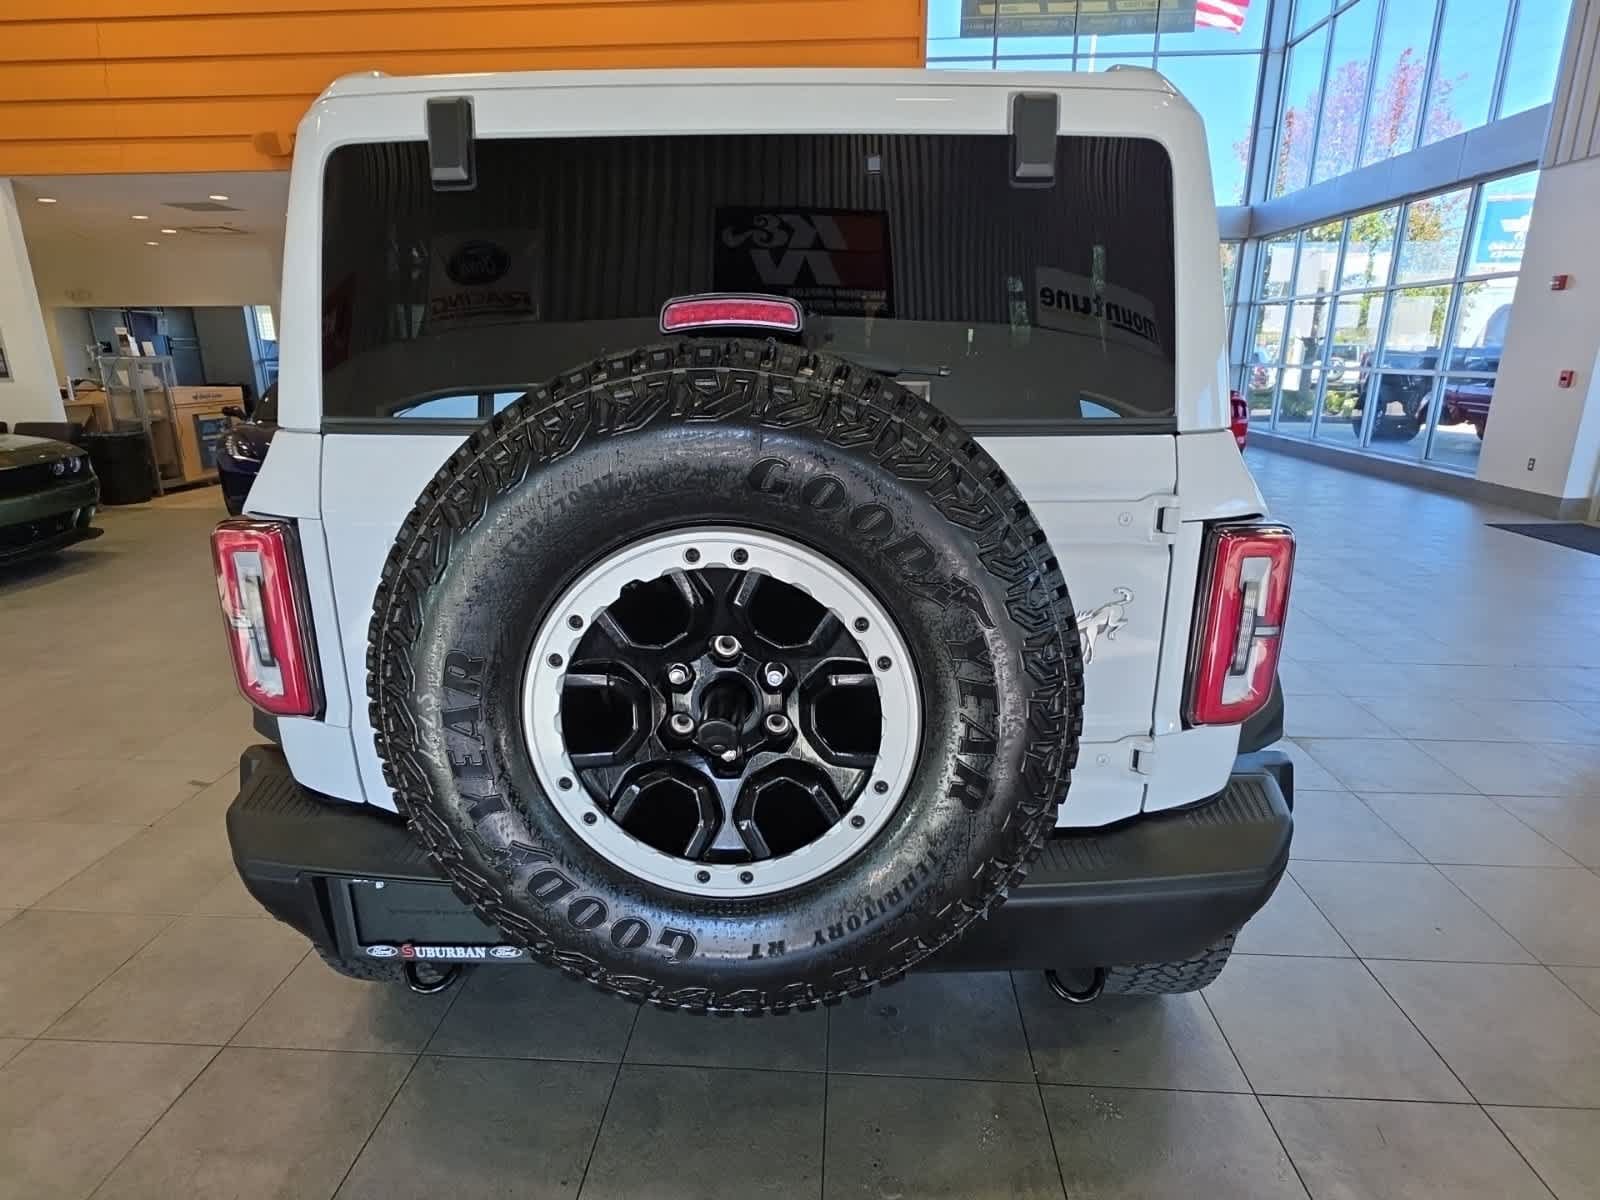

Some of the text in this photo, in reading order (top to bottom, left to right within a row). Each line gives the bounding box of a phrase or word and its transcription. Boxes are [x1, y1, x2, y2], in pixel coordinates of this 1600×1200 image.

[747, 849, 940, 961] TERRITORY RT
[401, 944, 486, 959] SUBURBAN
